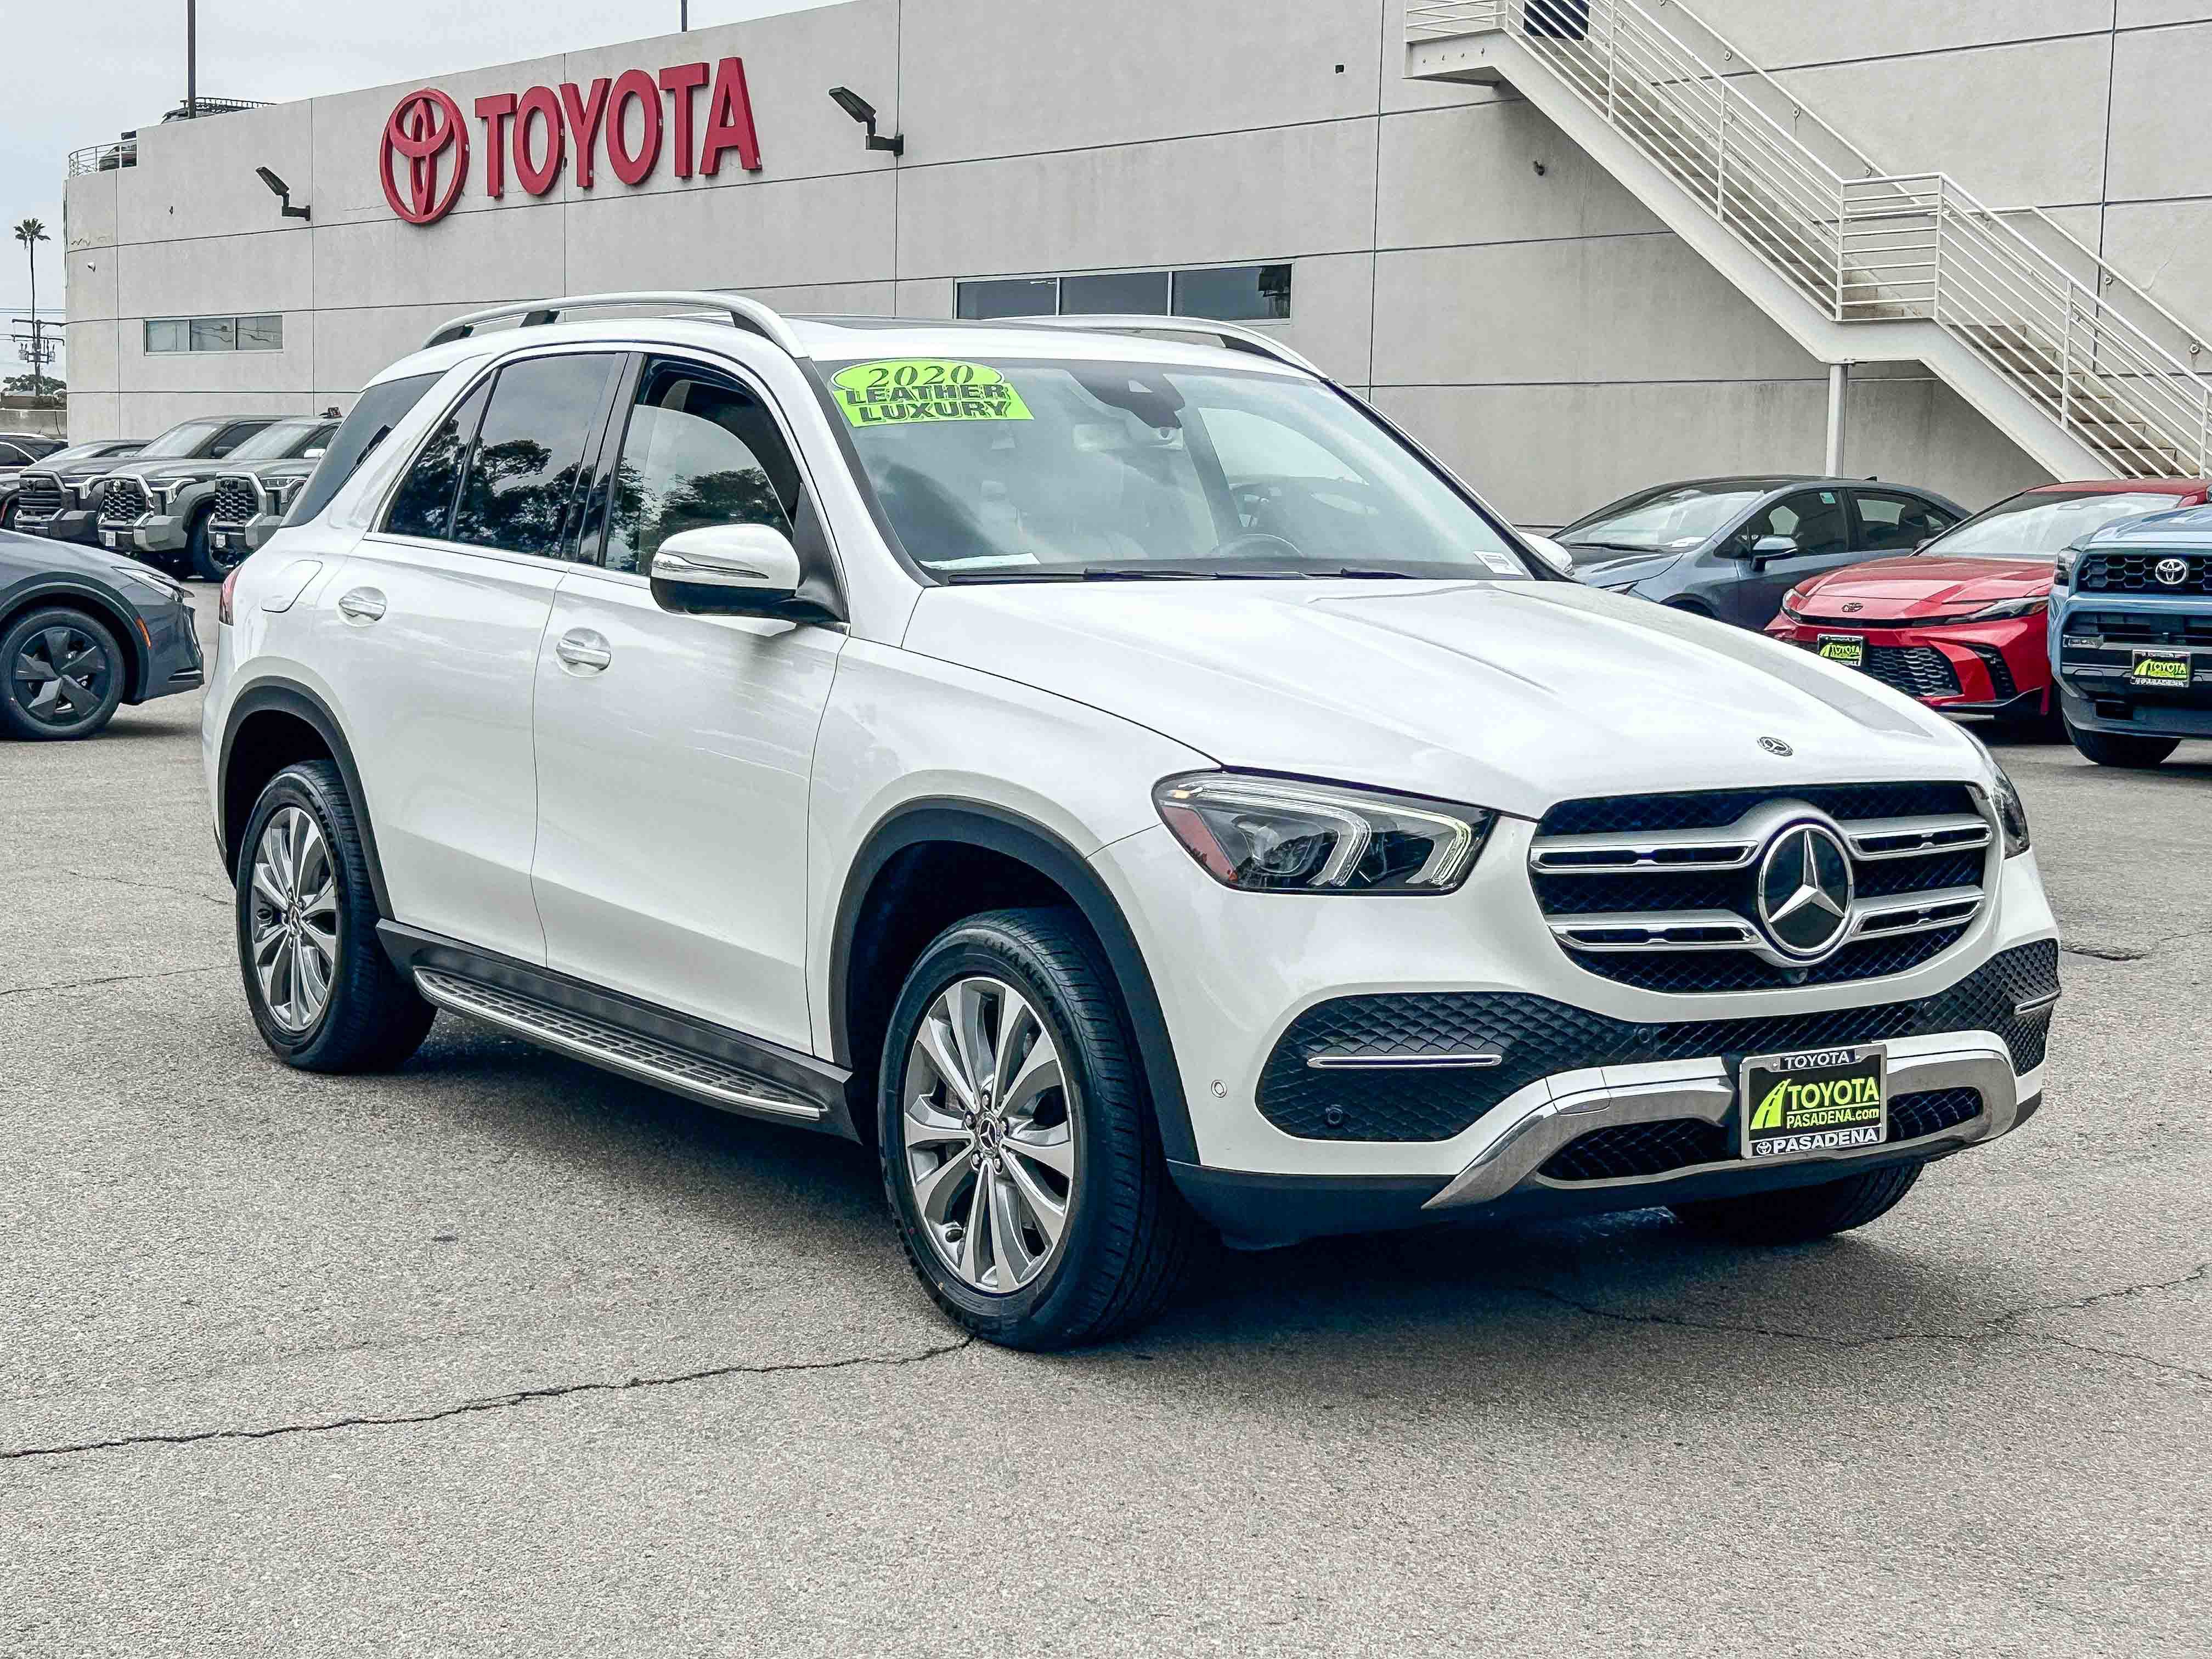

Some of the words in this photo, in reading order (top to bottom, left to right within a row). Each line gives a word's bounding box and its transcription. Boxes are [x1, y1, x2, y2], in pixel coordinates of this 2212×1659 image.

[475, 57, 763, 199] TOYOTA
[868, 365, 974, 387] 2020
[847, 383, 1011, 404] LEATHER
[859, 400, 1011, 422] LUXURY
[2149, 661, 2186, 674] TOYOTA
[1785, 1051, 1849, 1069] TOYOTA
[1787, 1076, 1879, 1110] TOYOTA
[1786, 1108, 1879, 1128] PASADENA.com
[1773, 1128, 1877, 1154] PASADENA
